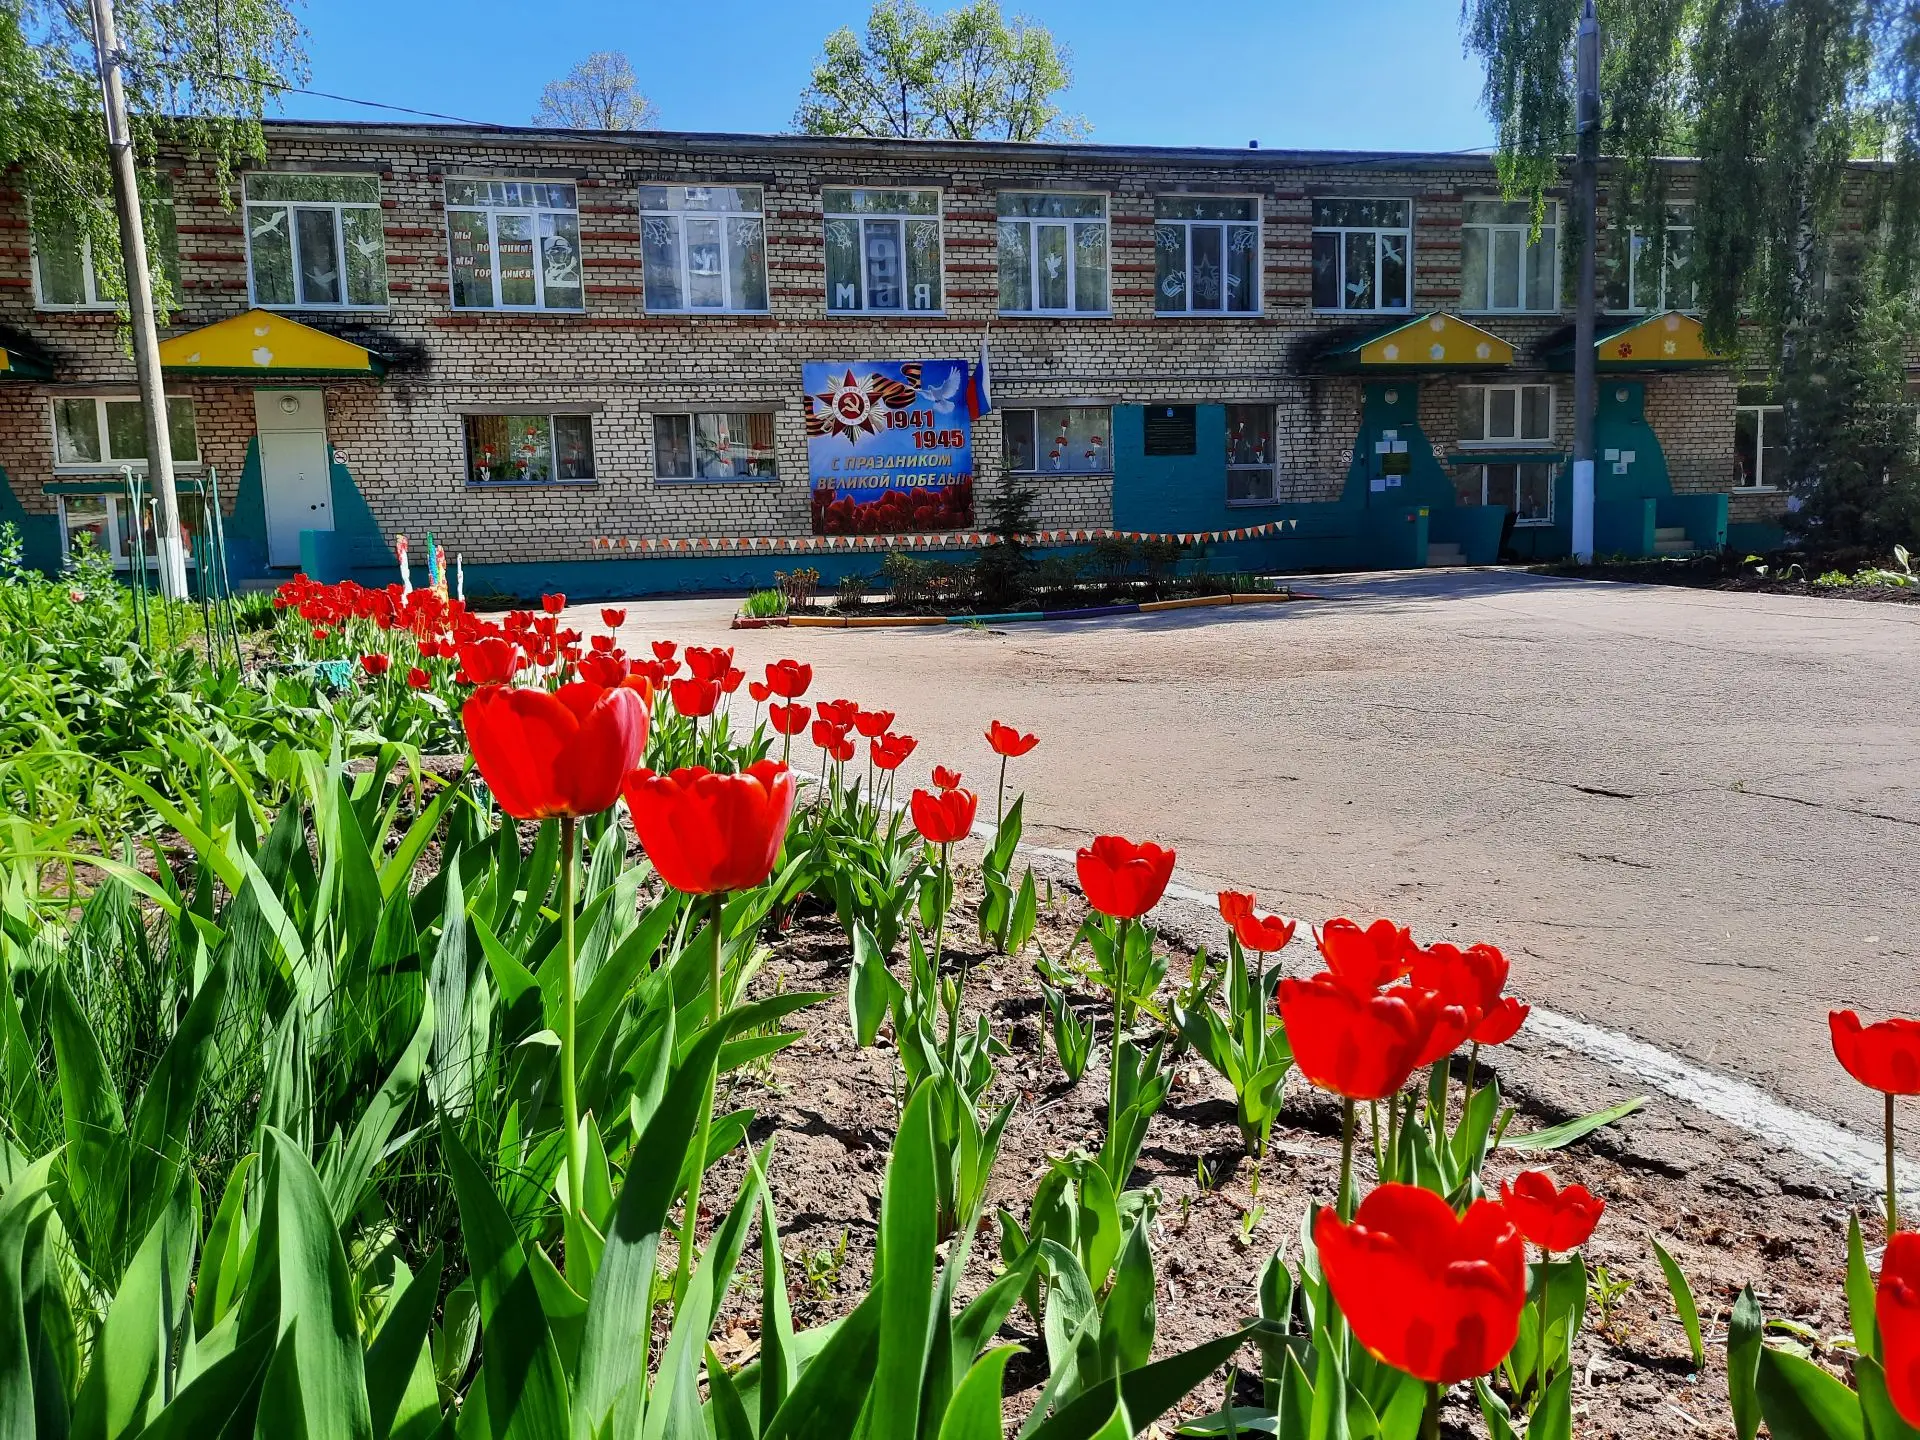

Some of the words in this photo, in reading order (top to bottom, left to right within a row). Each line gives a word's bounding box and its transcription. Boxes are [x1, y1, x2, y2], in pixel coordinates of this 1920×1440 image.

[454, 231, 472, 240] МЫ
[455, 256, 474, 265] МЫ
[883, 409, 934, 429] 1941
[912, 429, 964, 449] 1945
[831, 457, 840, 470] С
[844, 454, 952, 470] ПРАЗДНИКОМ
[817, 472, 890, 490] ВЕЛИКОЙ
